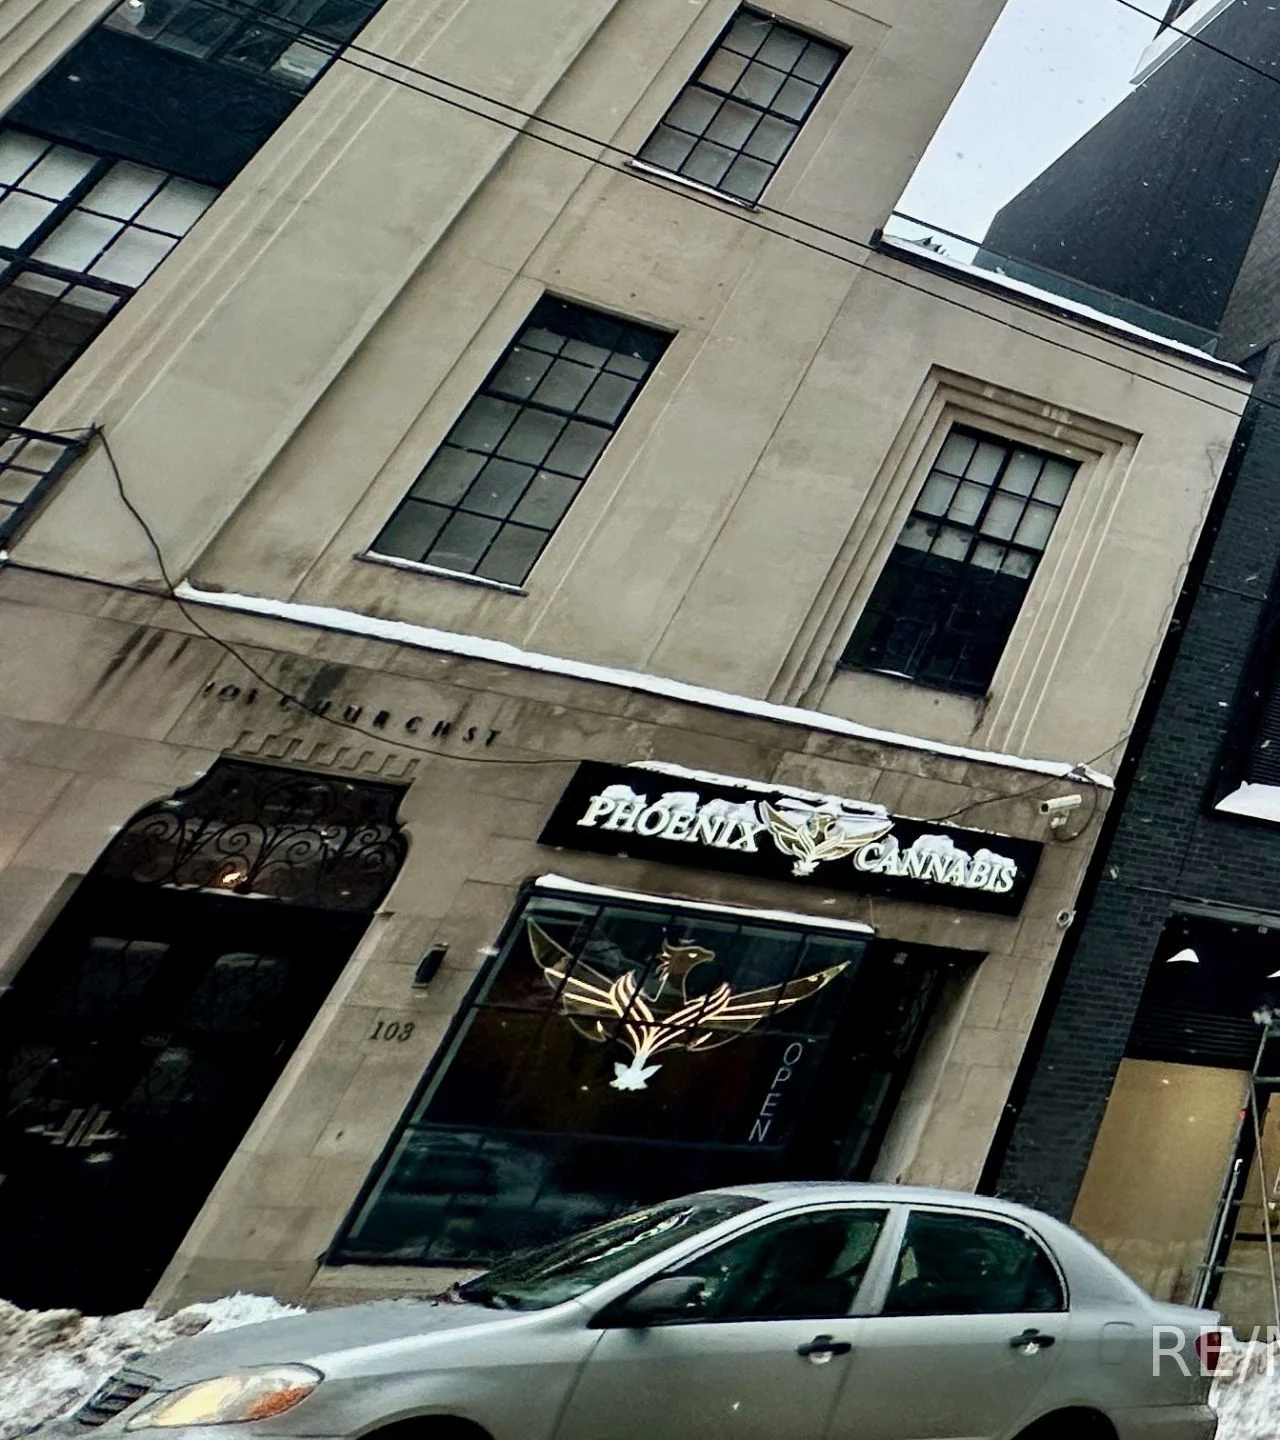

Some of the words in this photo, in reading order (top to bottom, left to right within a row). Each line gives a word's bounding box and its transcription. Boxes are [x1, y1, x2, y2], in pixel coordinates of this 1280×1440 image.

[279, 694, 451, 739] CHURCH
[577, 792, 768, 853] PHOENIX
[853, 838, 1018, 894] CANNABIS
[369, 1021, 416, 1043] 103
[748, 1042, 803, 1142] OPEN
